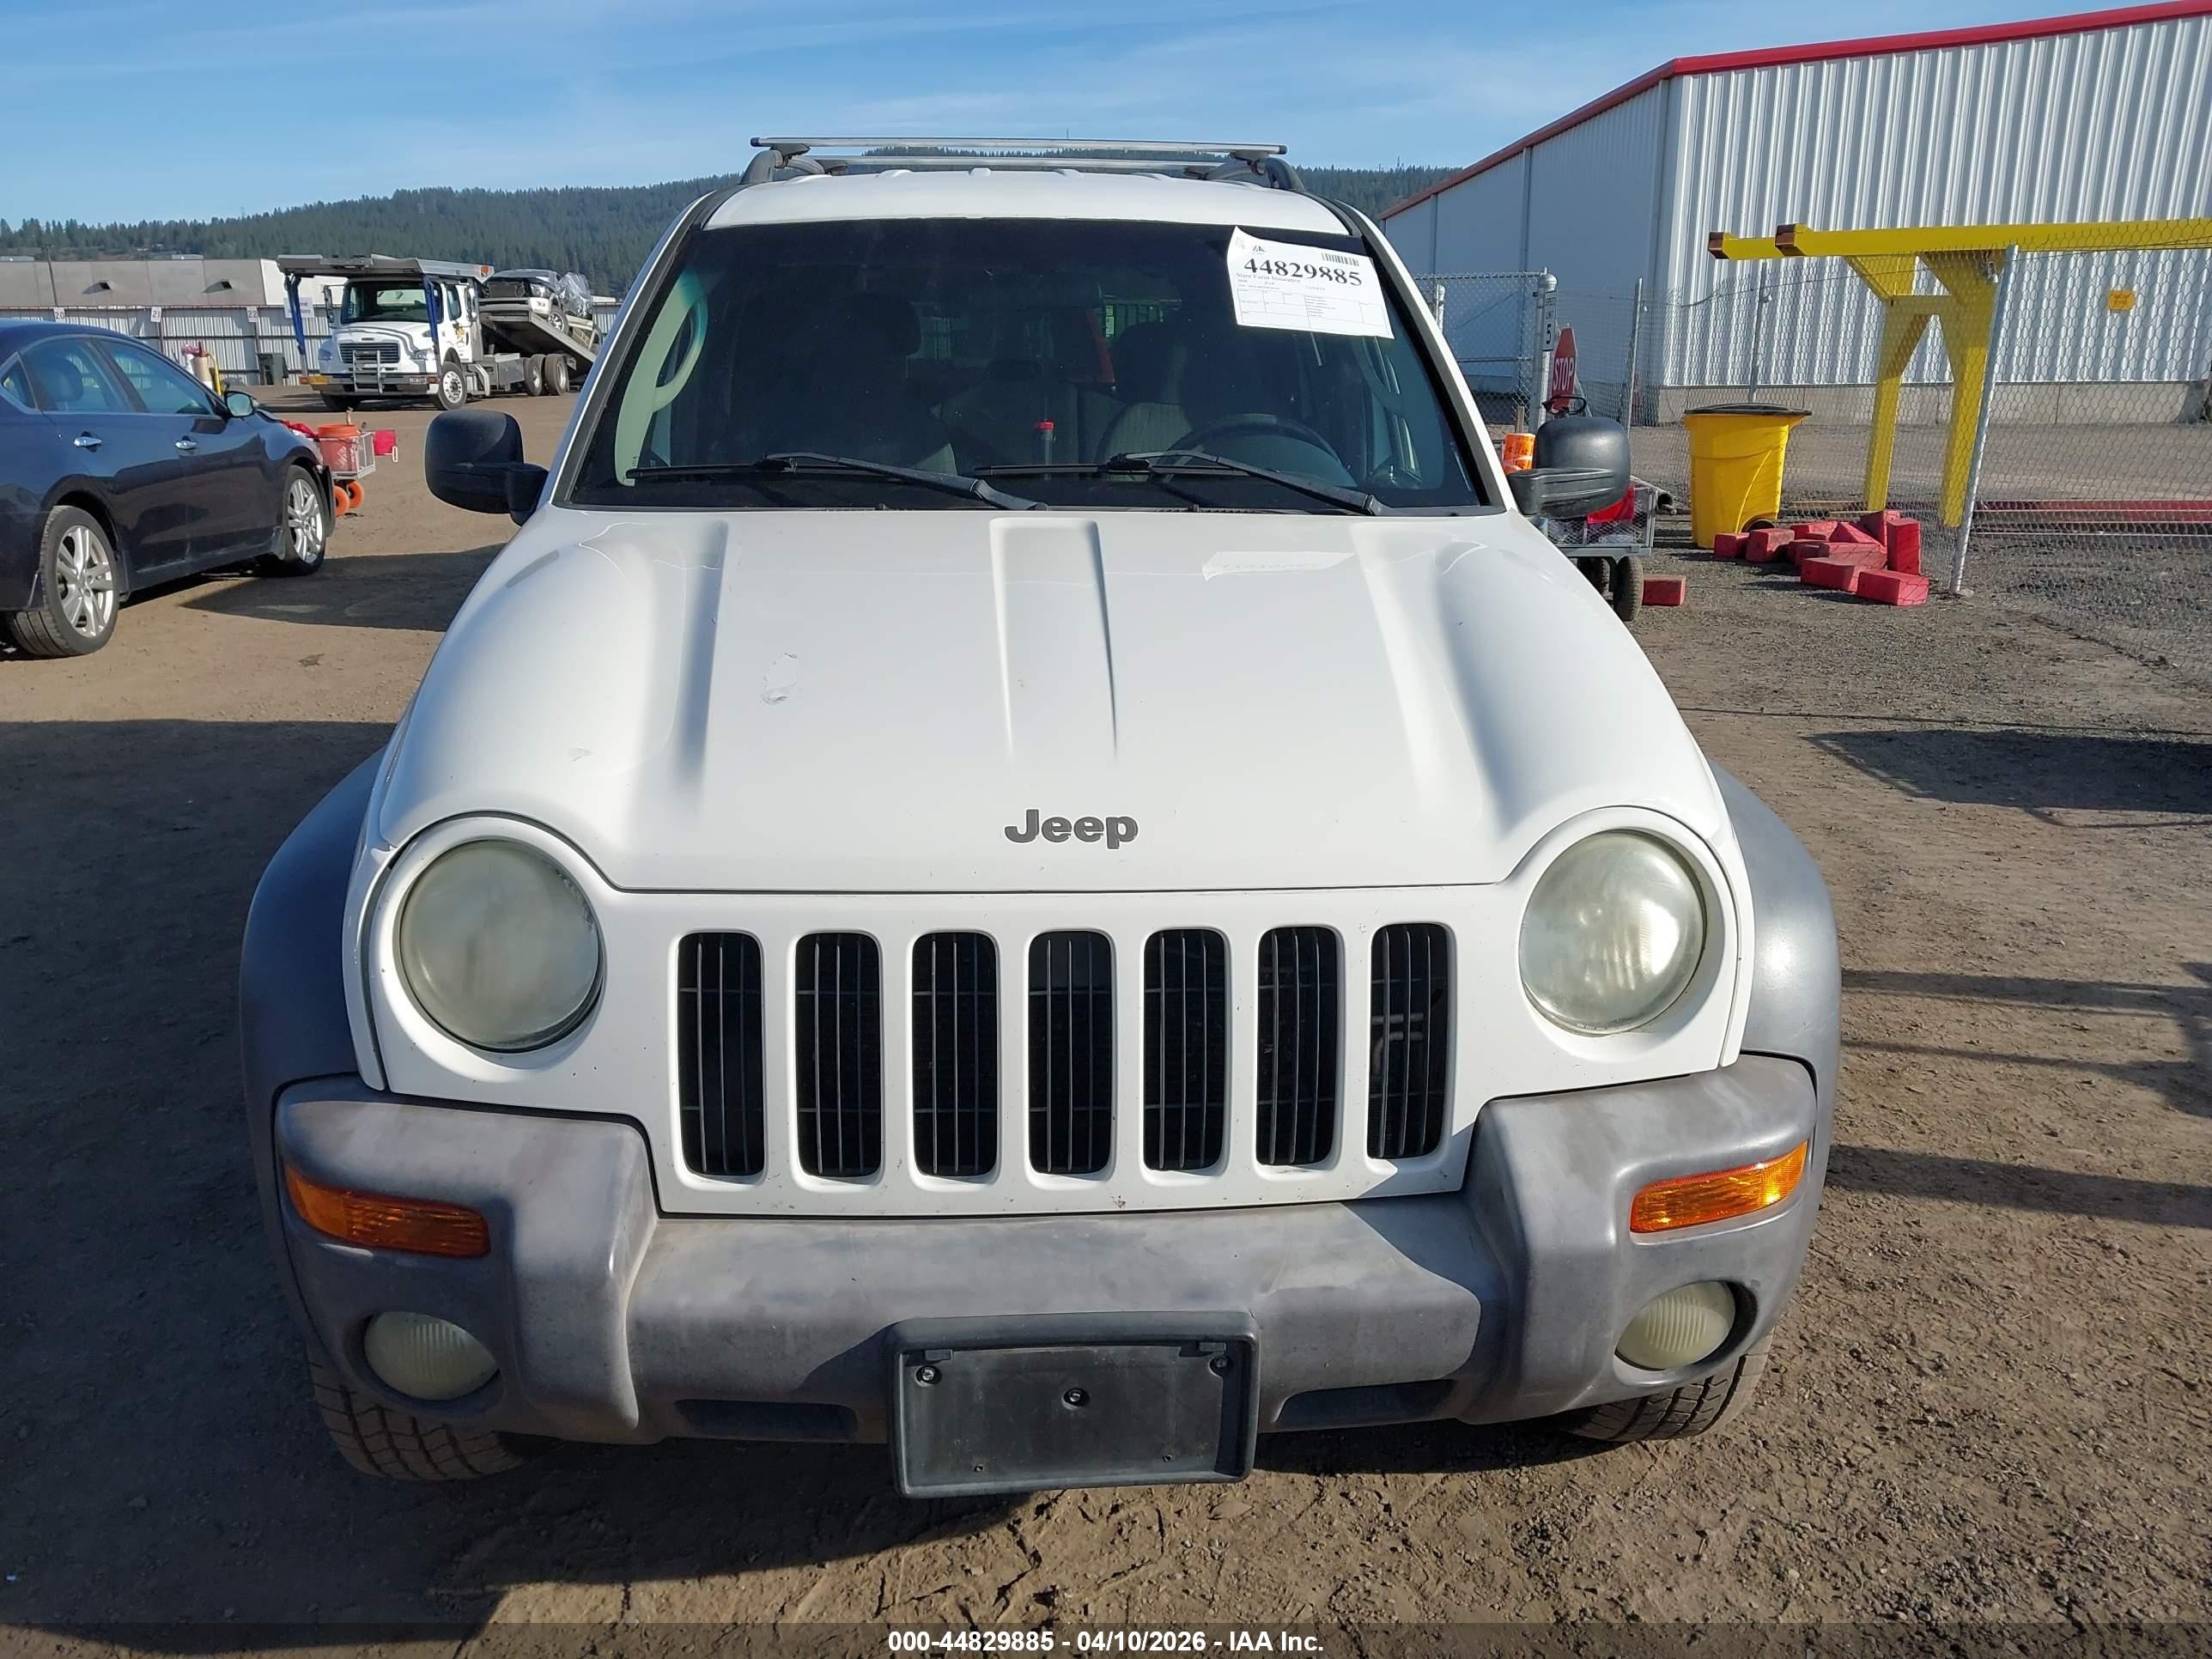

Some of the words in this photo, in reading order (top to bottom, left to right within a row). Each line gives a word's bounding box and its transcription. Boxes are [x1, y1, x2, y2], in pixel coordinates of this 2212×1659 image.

[1244, 258, 1362, 286] 44829885
[1546, 324, 1552, 344] 5
[1553, 357, 1574, 391] STOP
[1005, 809, 1139, 849] Jeep
